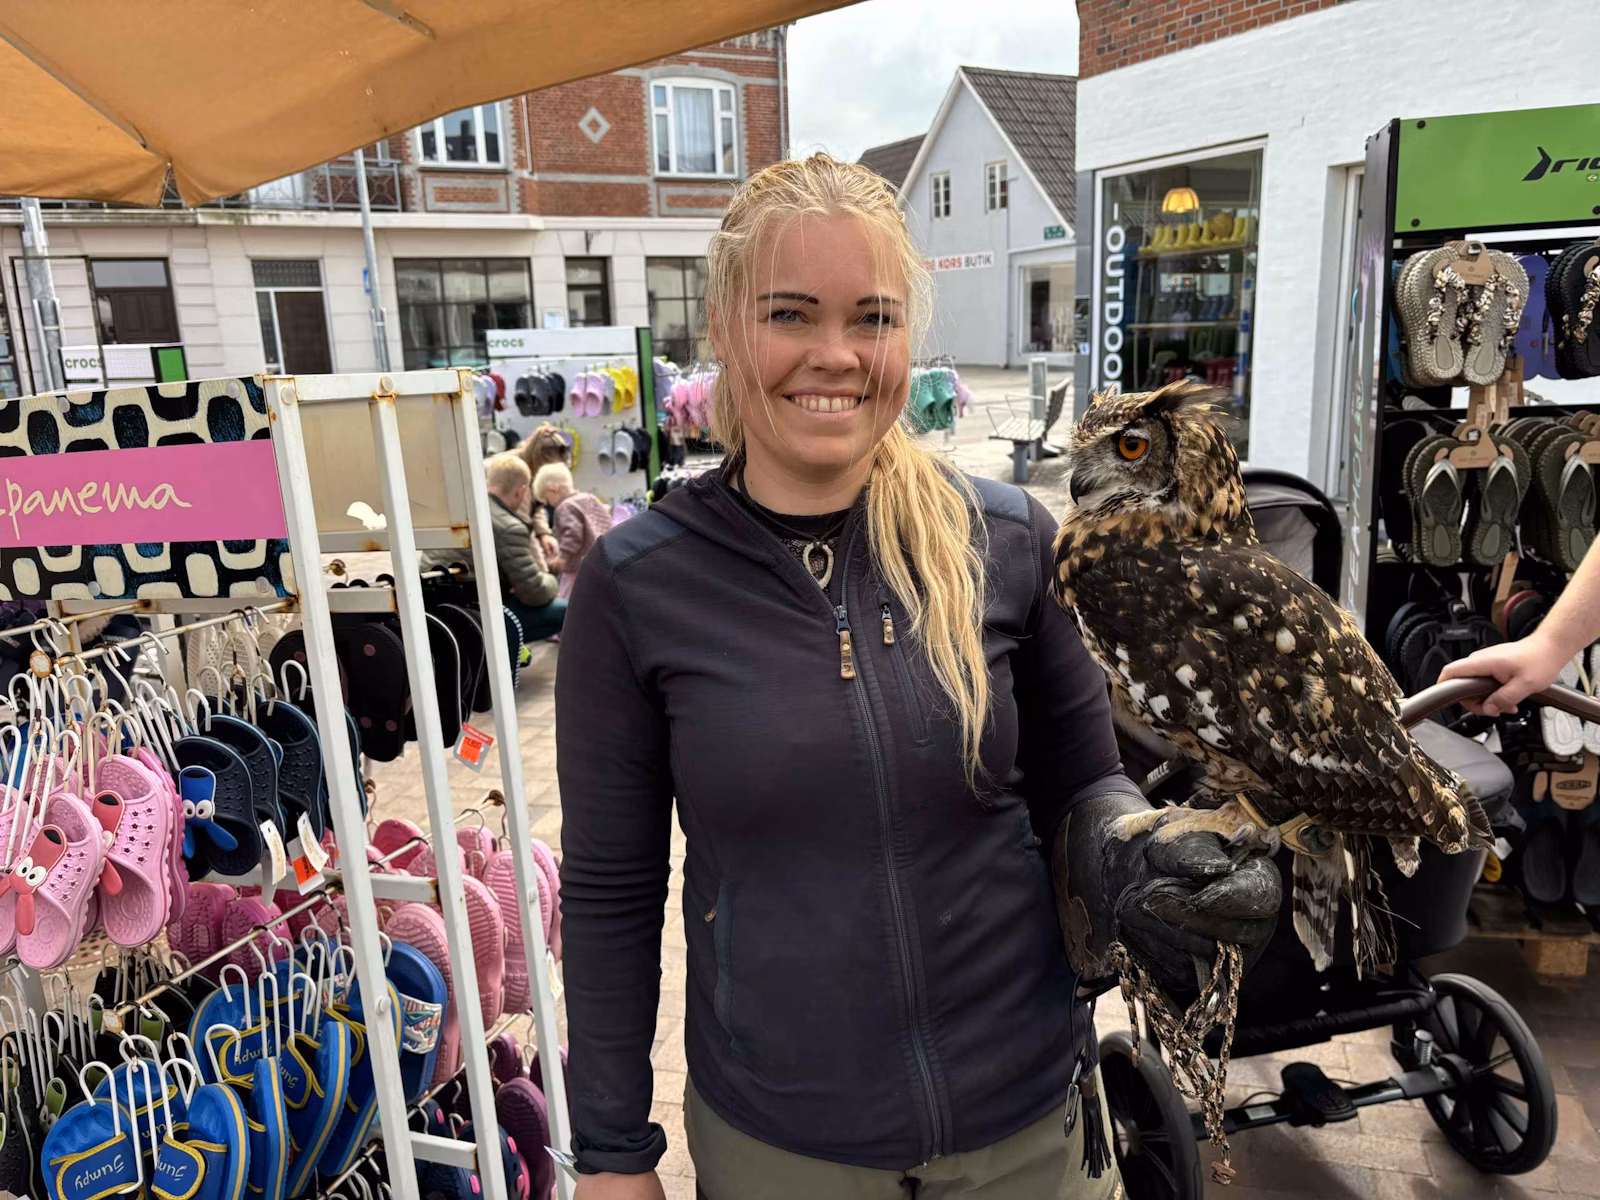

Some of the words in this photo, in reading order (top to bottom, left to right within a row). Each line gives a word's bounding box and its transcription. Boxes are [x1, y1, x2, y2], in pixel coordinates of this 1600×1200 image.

[964, 254, 993, 268] BUTIK
[487, 338, 525, 348] crocs
[0, 478, 192, 540] panema
[75, 1154, 124, 1191] Jumpy
